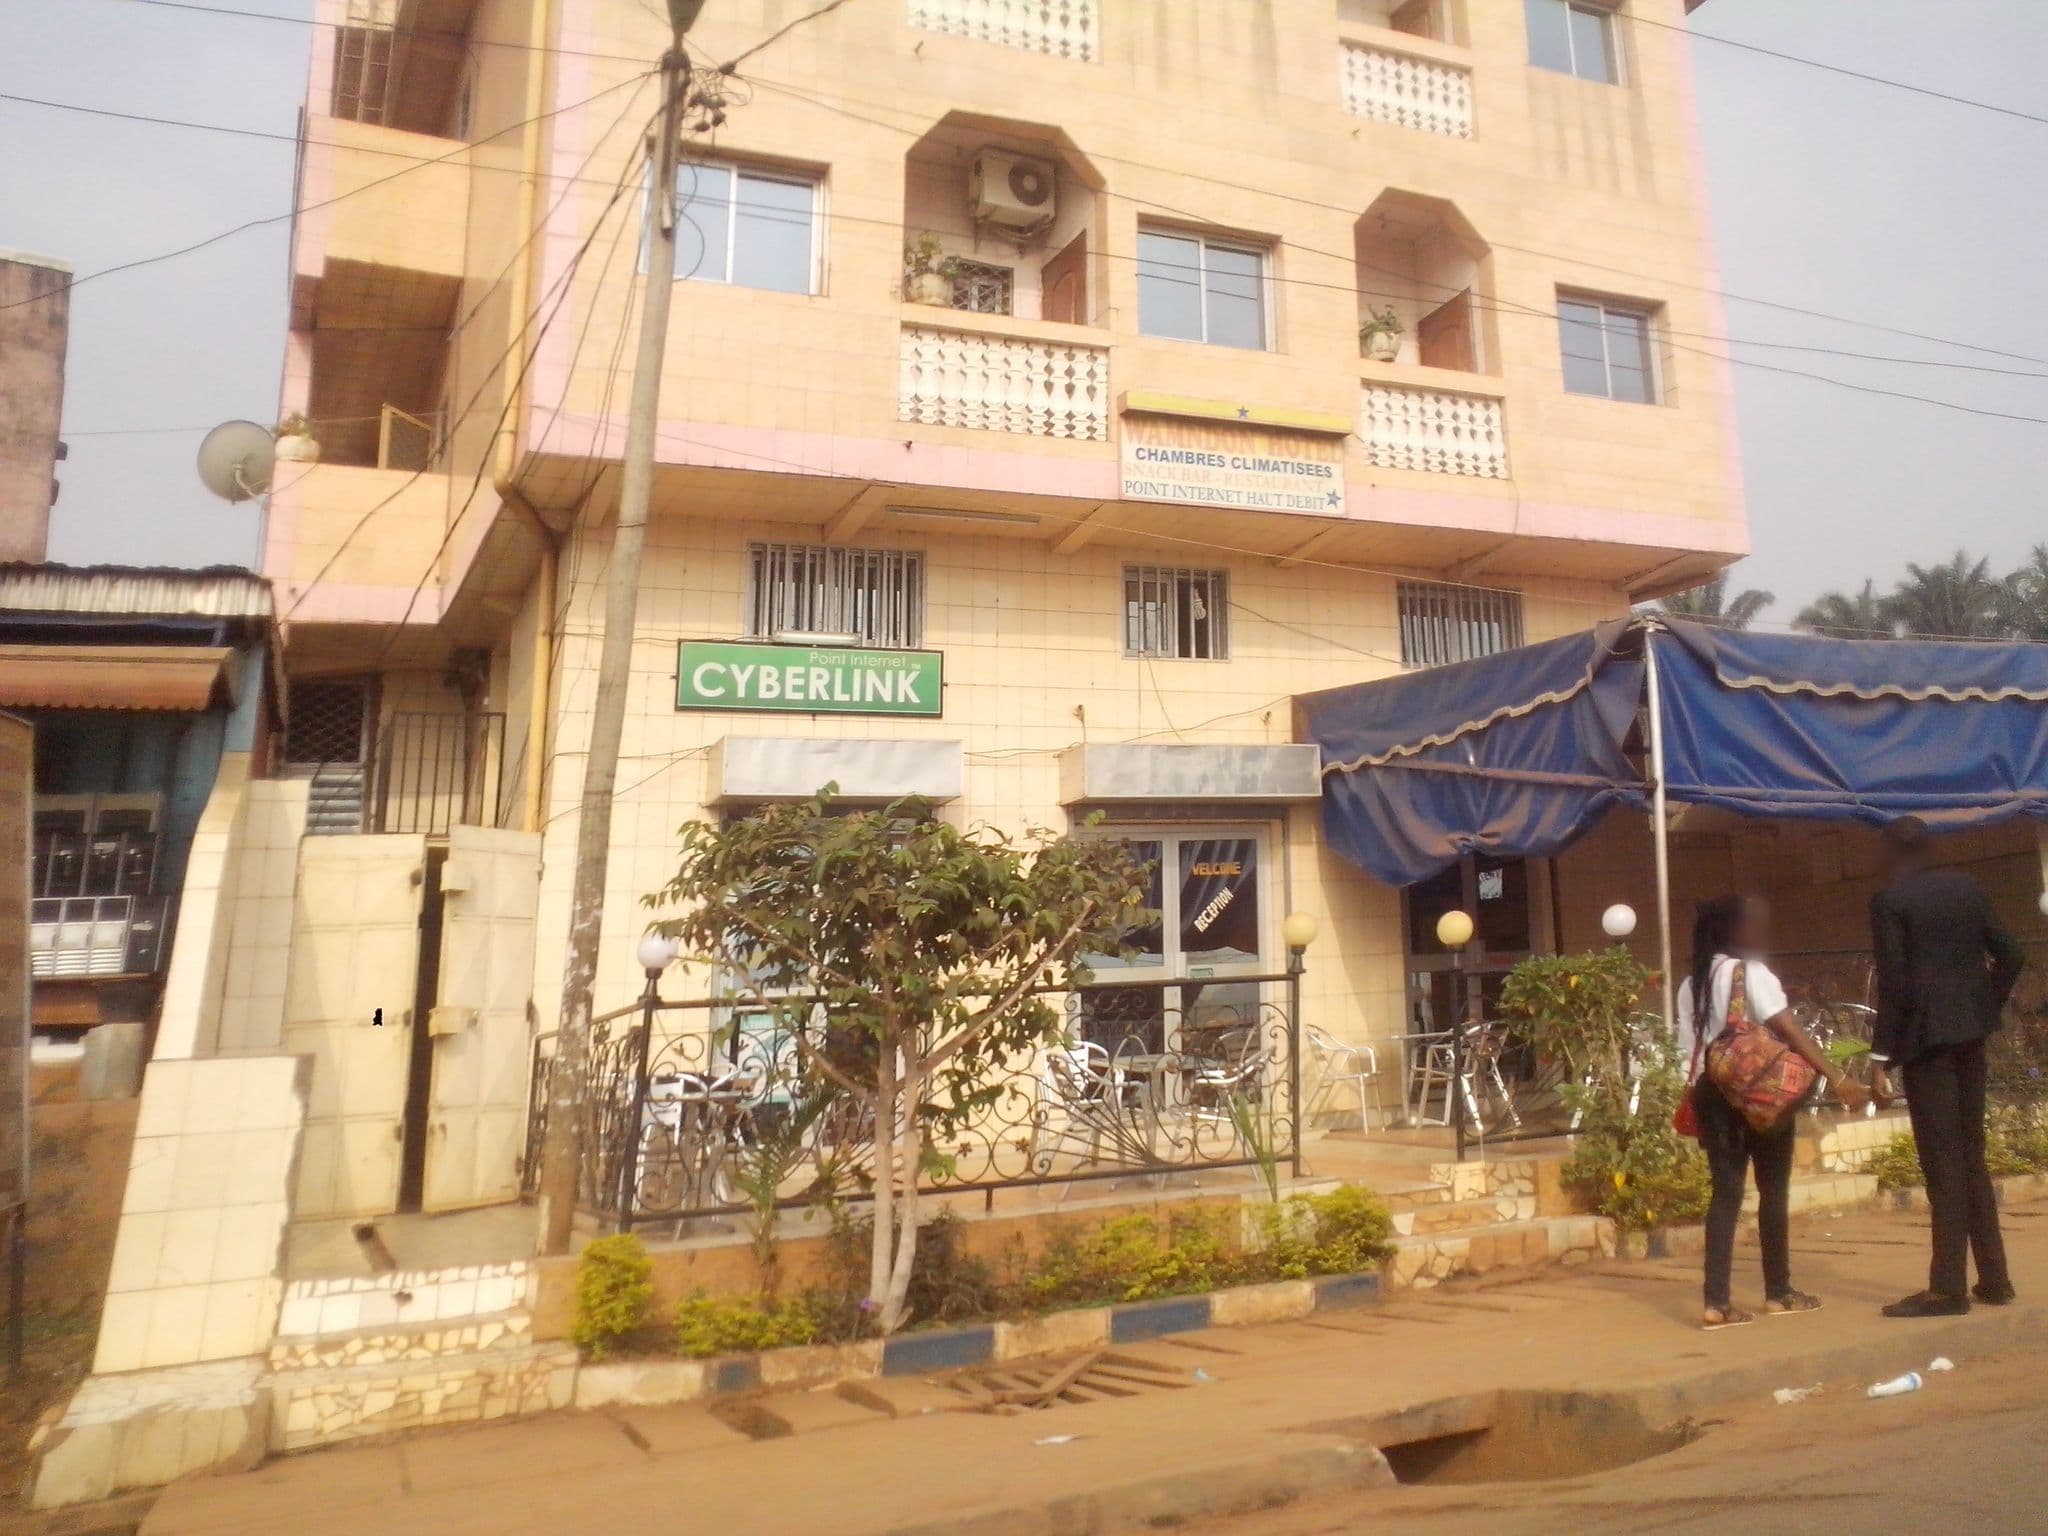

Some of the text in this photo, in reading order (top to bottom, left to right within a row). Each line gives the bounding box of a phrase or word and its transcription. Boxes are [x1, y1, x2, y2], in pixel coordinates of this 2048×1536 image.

[1124, 462, 1176, 480] SNACK
[1224, 471, 1323, 492] RESTAURANT
[1135, 447, 1333, 478] CHAMBRES CLIMATISEES
[1125, 480, 1326, 510] POINT INTERNET HAUT DEBIT
[809, 652, 906, 667] Point Internet
[693, 662, 921, 704] CYBERLINK
[1192, 862, 1241, 875] WELCOME
[1193, 886, 1235, 933] RECEPTION
